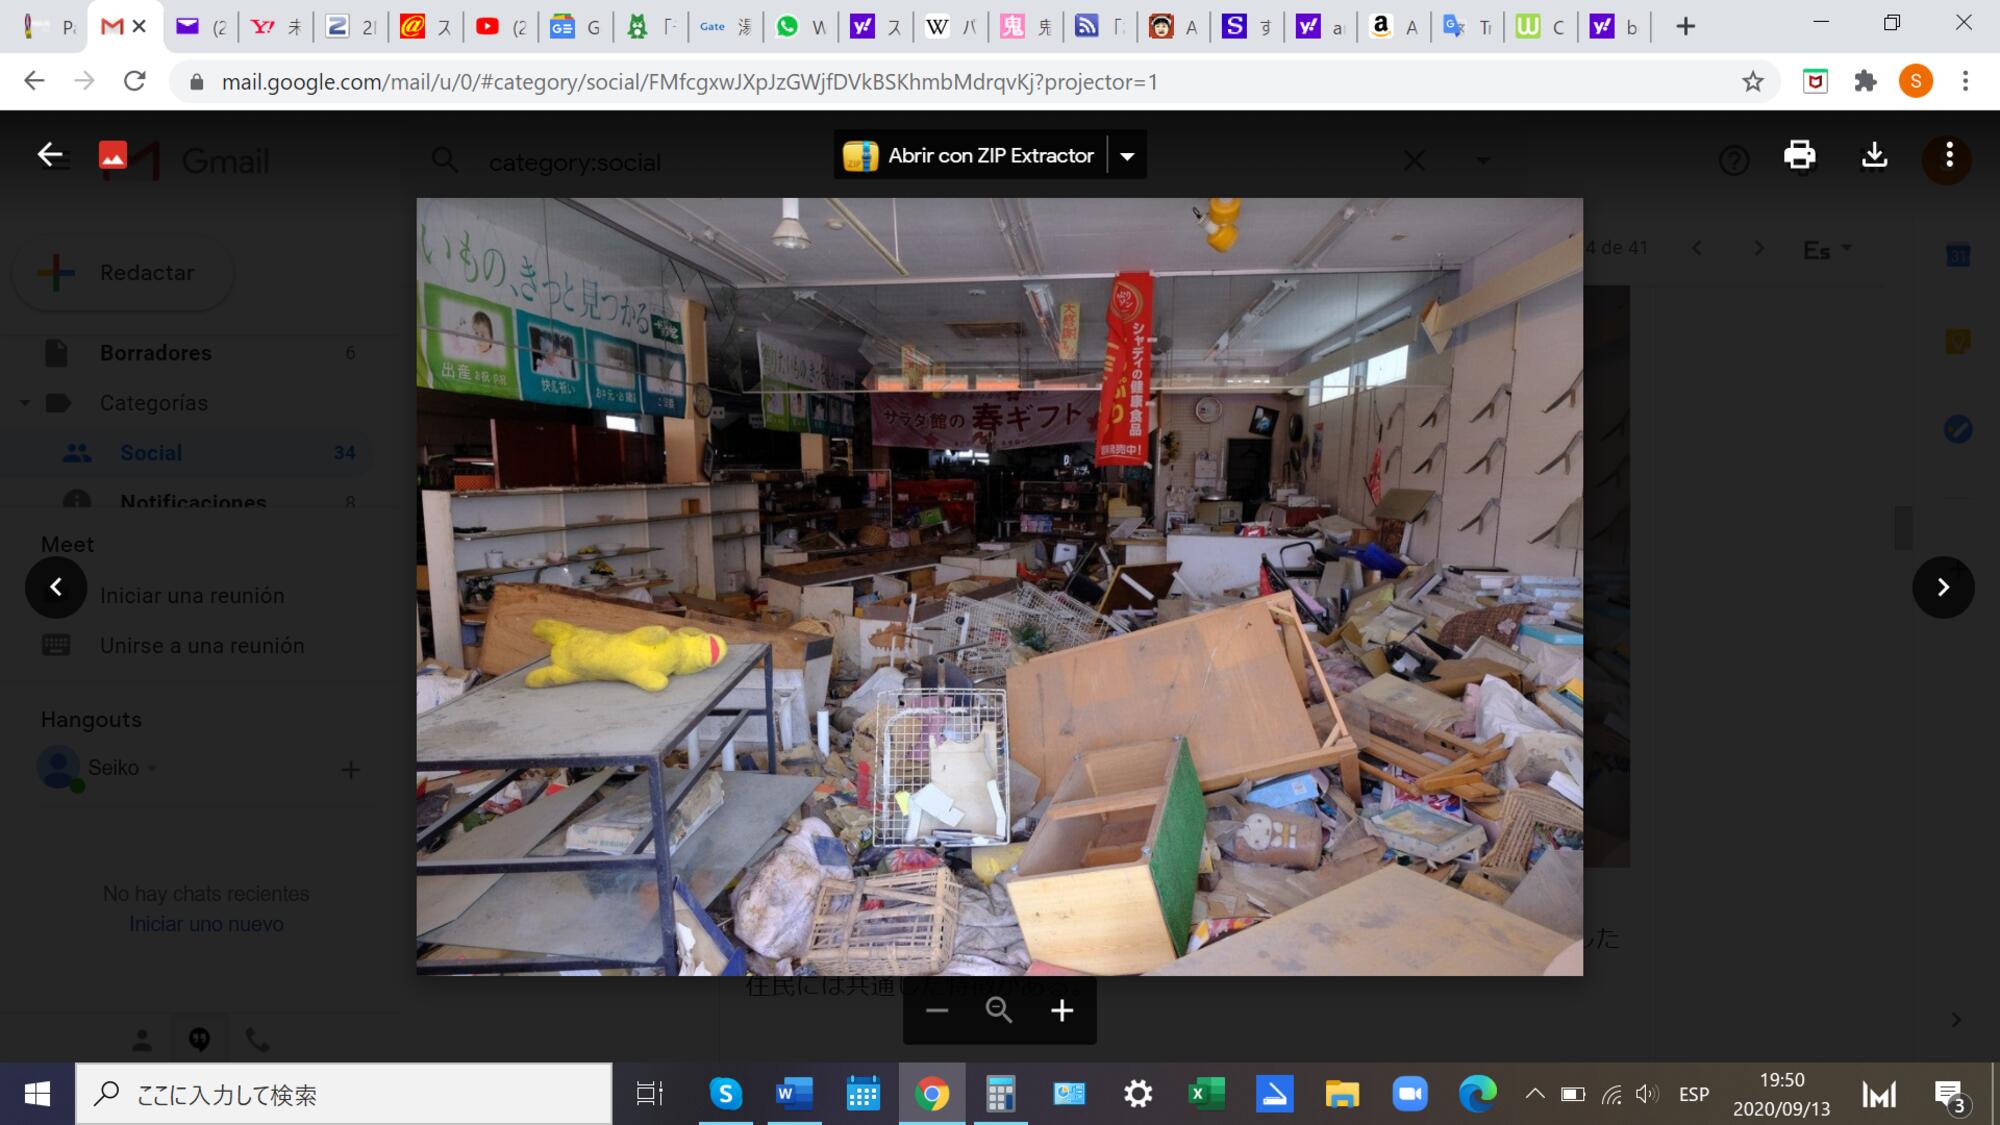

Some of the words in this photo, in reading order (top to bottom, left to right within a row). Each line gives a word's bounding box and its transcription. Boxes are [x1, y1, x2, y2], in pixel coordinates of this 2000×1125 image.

[699, 22, 726, 31] Gate
[182, 147, 271, 175] Gmail
[487, 152, 661, 177] category:social
[888, 146, 935, 164] Abrir
[938, 151, 973, 164] con
[977, 147, 1007, 164] ZIP
[1011, 147, 1095, 164] Extractor
[1601, 239, 1625, 256] de
[1628, 240, 1647, 255] 41
[1803, 240, 1831, 260] Es
[100, 263, 196, 281] Redactar
[100, 343, 212, 362] Borradores
[345, 344, 356, 361] 6
[1130, 322, 1145, 437] シャディの健康食品
[100, 392, 209, 416] Categorías
[971, 402, 1082, 434] 春ギフト
[120, 443, 183, 463] Social
[333, 445, 357, 461] 34
[41, 535, 95, 553] Meet
[101, 586, 163, 604] Iniciar
[168, 591, 204, 605] una
[210, 585, 285, 605] reunión
[100, 636, 164, 655] Unirse
[170, 641, 182, 656] a
[188, 640, 224, 656] una
[230, 635, 305, 655] reunión
[41, 711, 142, 734] Hangouts
[87, 758, 140, 777] Seiko
[103, 884, 129, 903] No
[135, 885, 168, 906] hay
[172, 885, 222, 903] chats
[227, 884, 311, 903] recientes
[129, 914, 184, 933] Iniciar
[189, 919, 225, 934] uno
[228, 919, 286, 933] nuevo
[1760, 1072, 1805, 1088] 19:50
[138, 1083, 317, 1107] ここに入力して検索
[1679, 1086, 1710, 1102] ESP
[1733, 1101, 1831, 1119] 2020/09/13
[1954, 1099, 1965, 1114] 3
